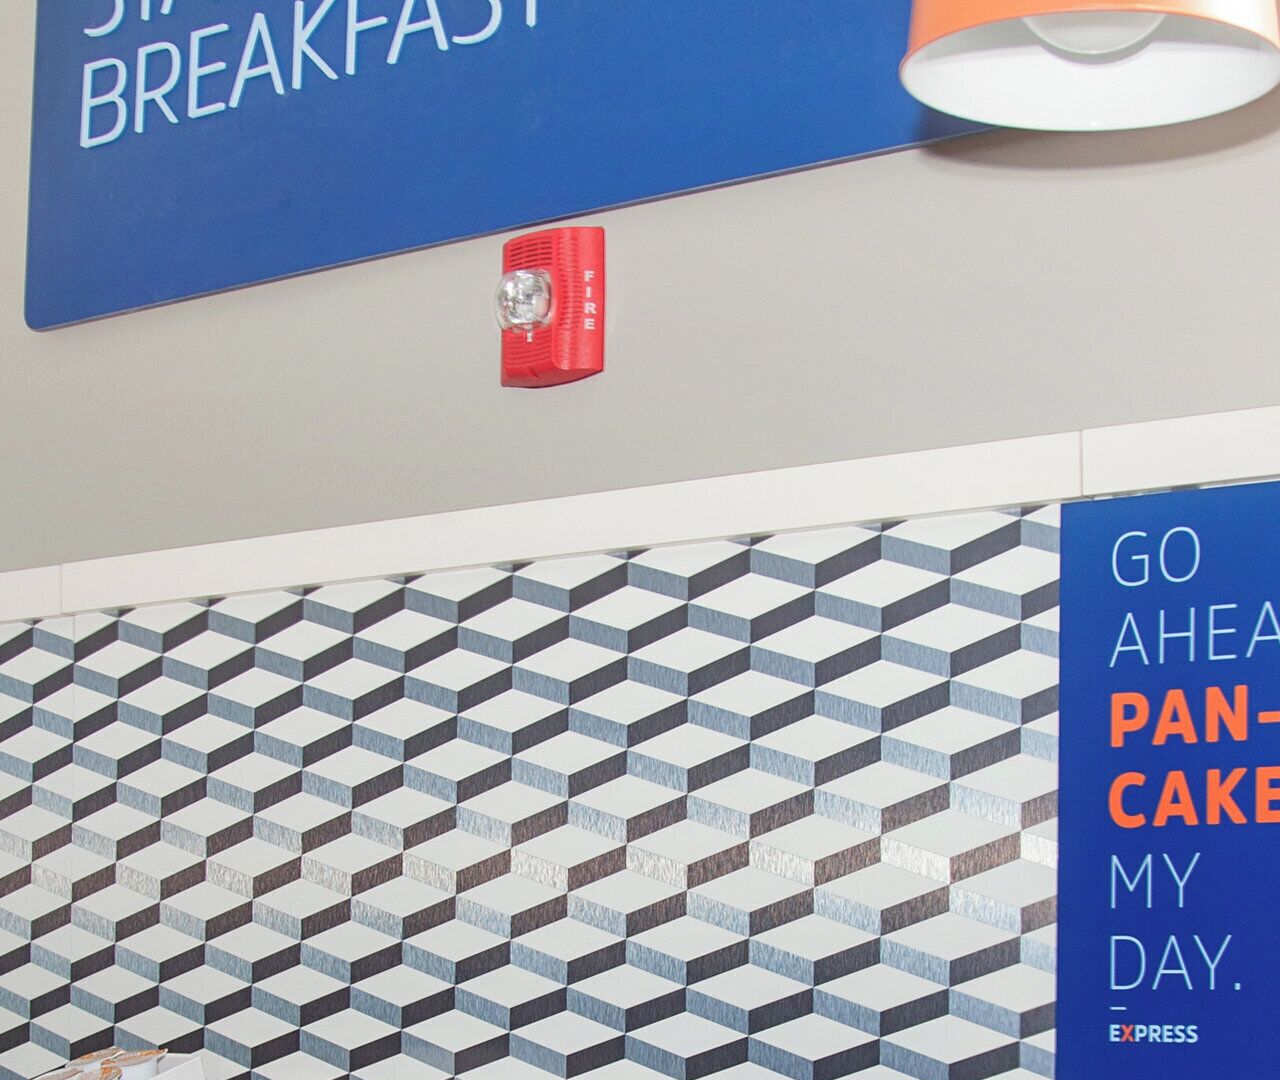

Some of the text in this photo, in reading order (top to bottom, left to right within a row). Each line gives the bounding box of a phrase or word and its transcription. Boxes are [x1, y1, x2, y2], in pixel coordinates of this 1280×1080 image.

[583, 270, 597, 330] FIRE
[1111, 526, 1201, 587] GO
[1110, 851, 1201, 909] MY
[1109, 933, 1242, 991] DAY.
[1108, 1023, 1199, 1043] EXPRESS
